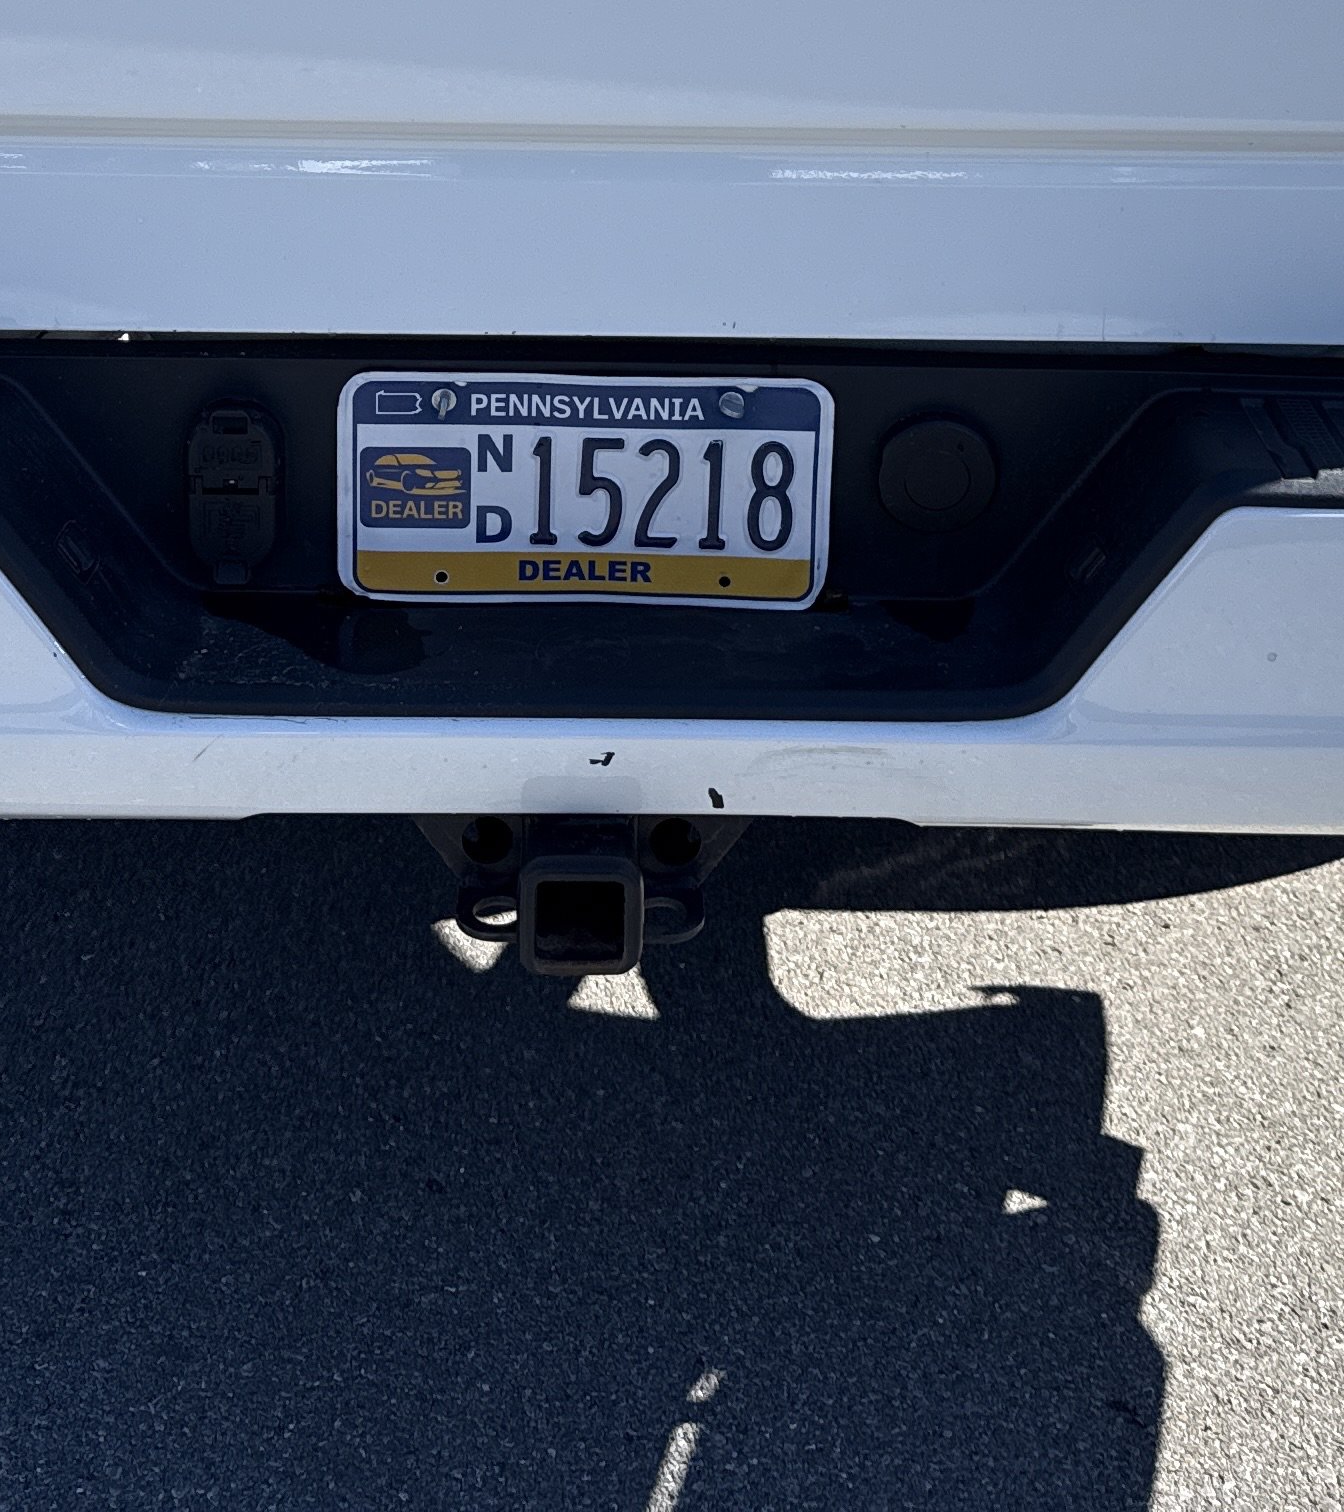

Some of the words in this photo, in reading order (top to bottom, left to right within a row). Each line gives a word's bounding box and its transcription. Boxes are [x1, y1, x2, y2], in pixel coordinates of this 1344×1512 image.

[470, 392, 706, 422] PENNSYLVANIA
[529, 436, 796, 553] 15218
[370, 499, 464, 520] DEALER
[517, 559, 653, 584] DEALER
